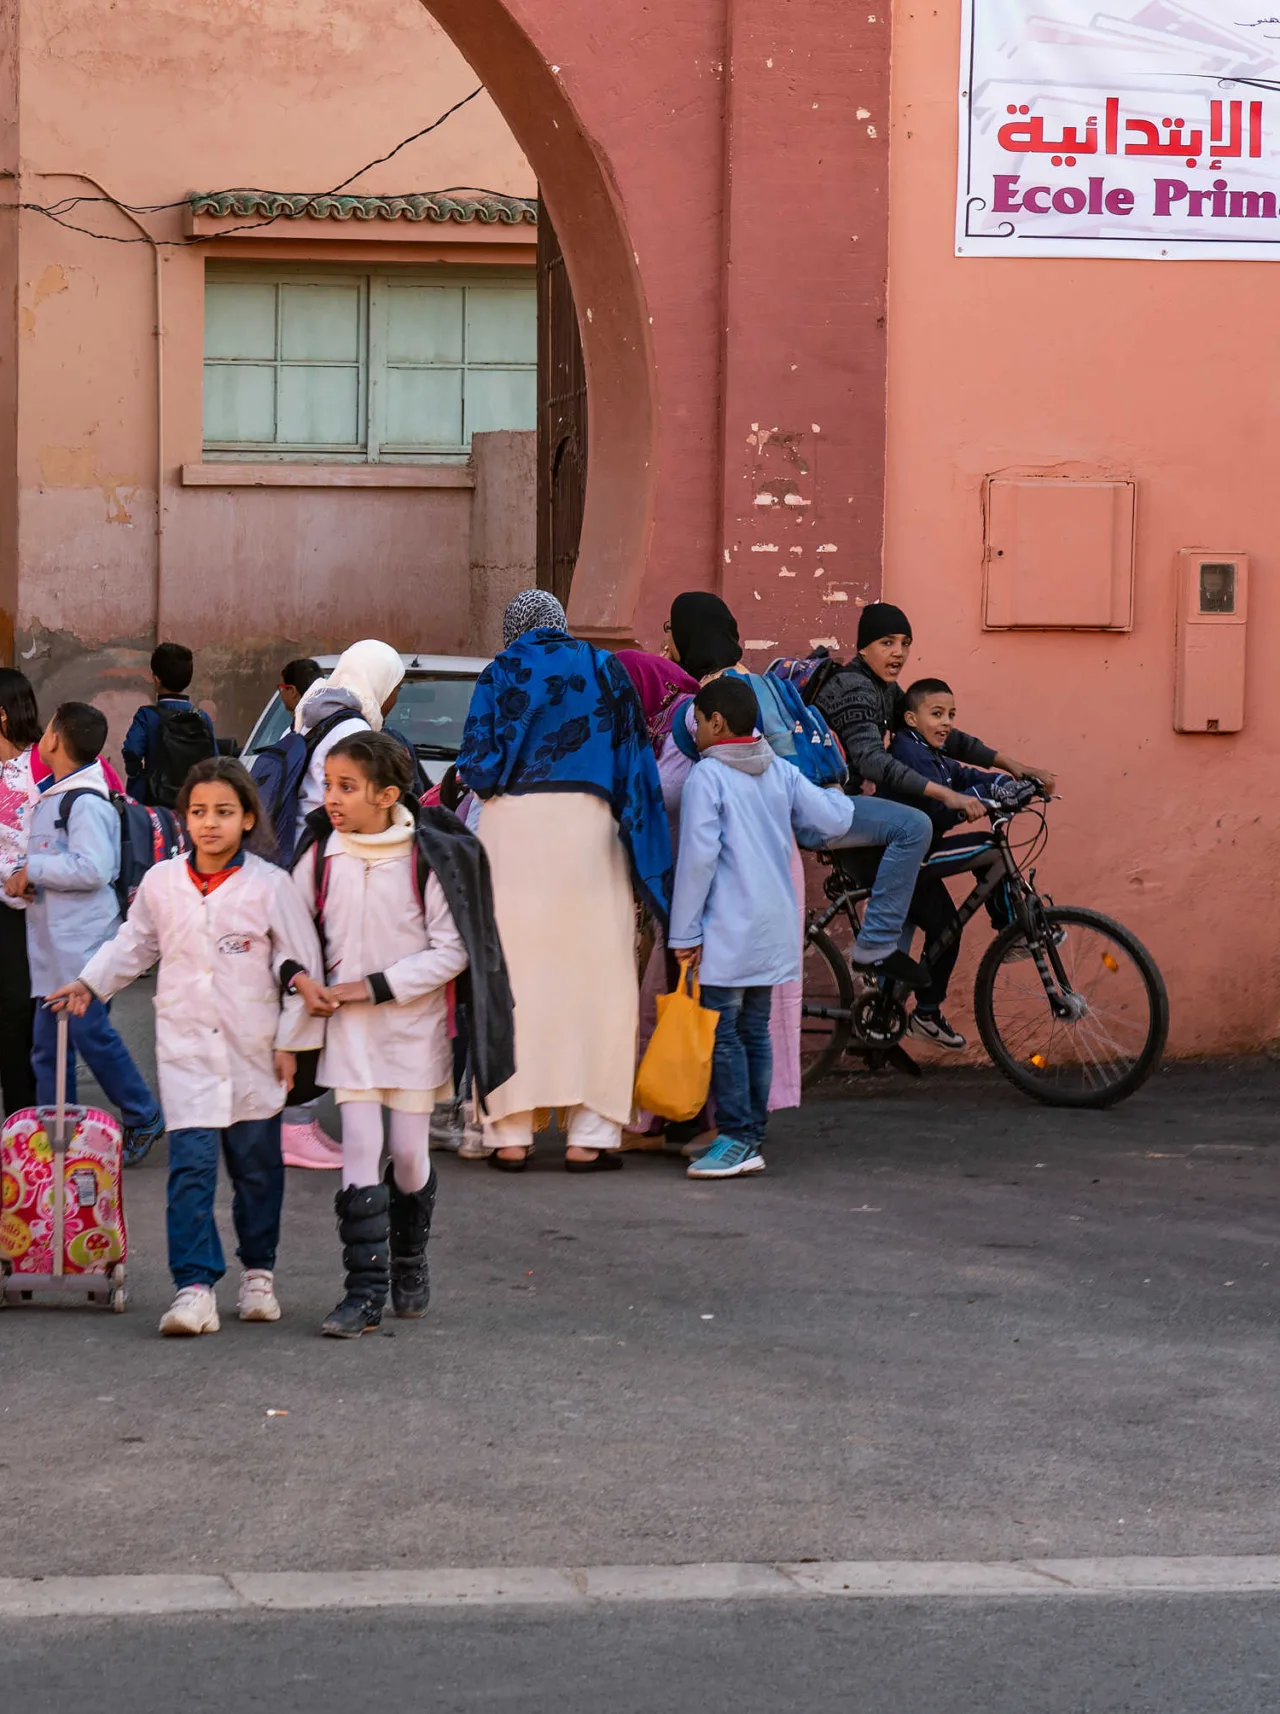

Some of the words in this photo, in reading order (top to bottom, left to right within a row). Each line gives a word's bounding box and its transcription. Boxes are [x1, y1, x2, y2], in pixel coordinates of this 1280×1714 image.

[997, 96, 1264, 171] الإبتدائية
[991, 174, 1135, 216] Ecole
[1153, 178, 1280, 219] Prim
